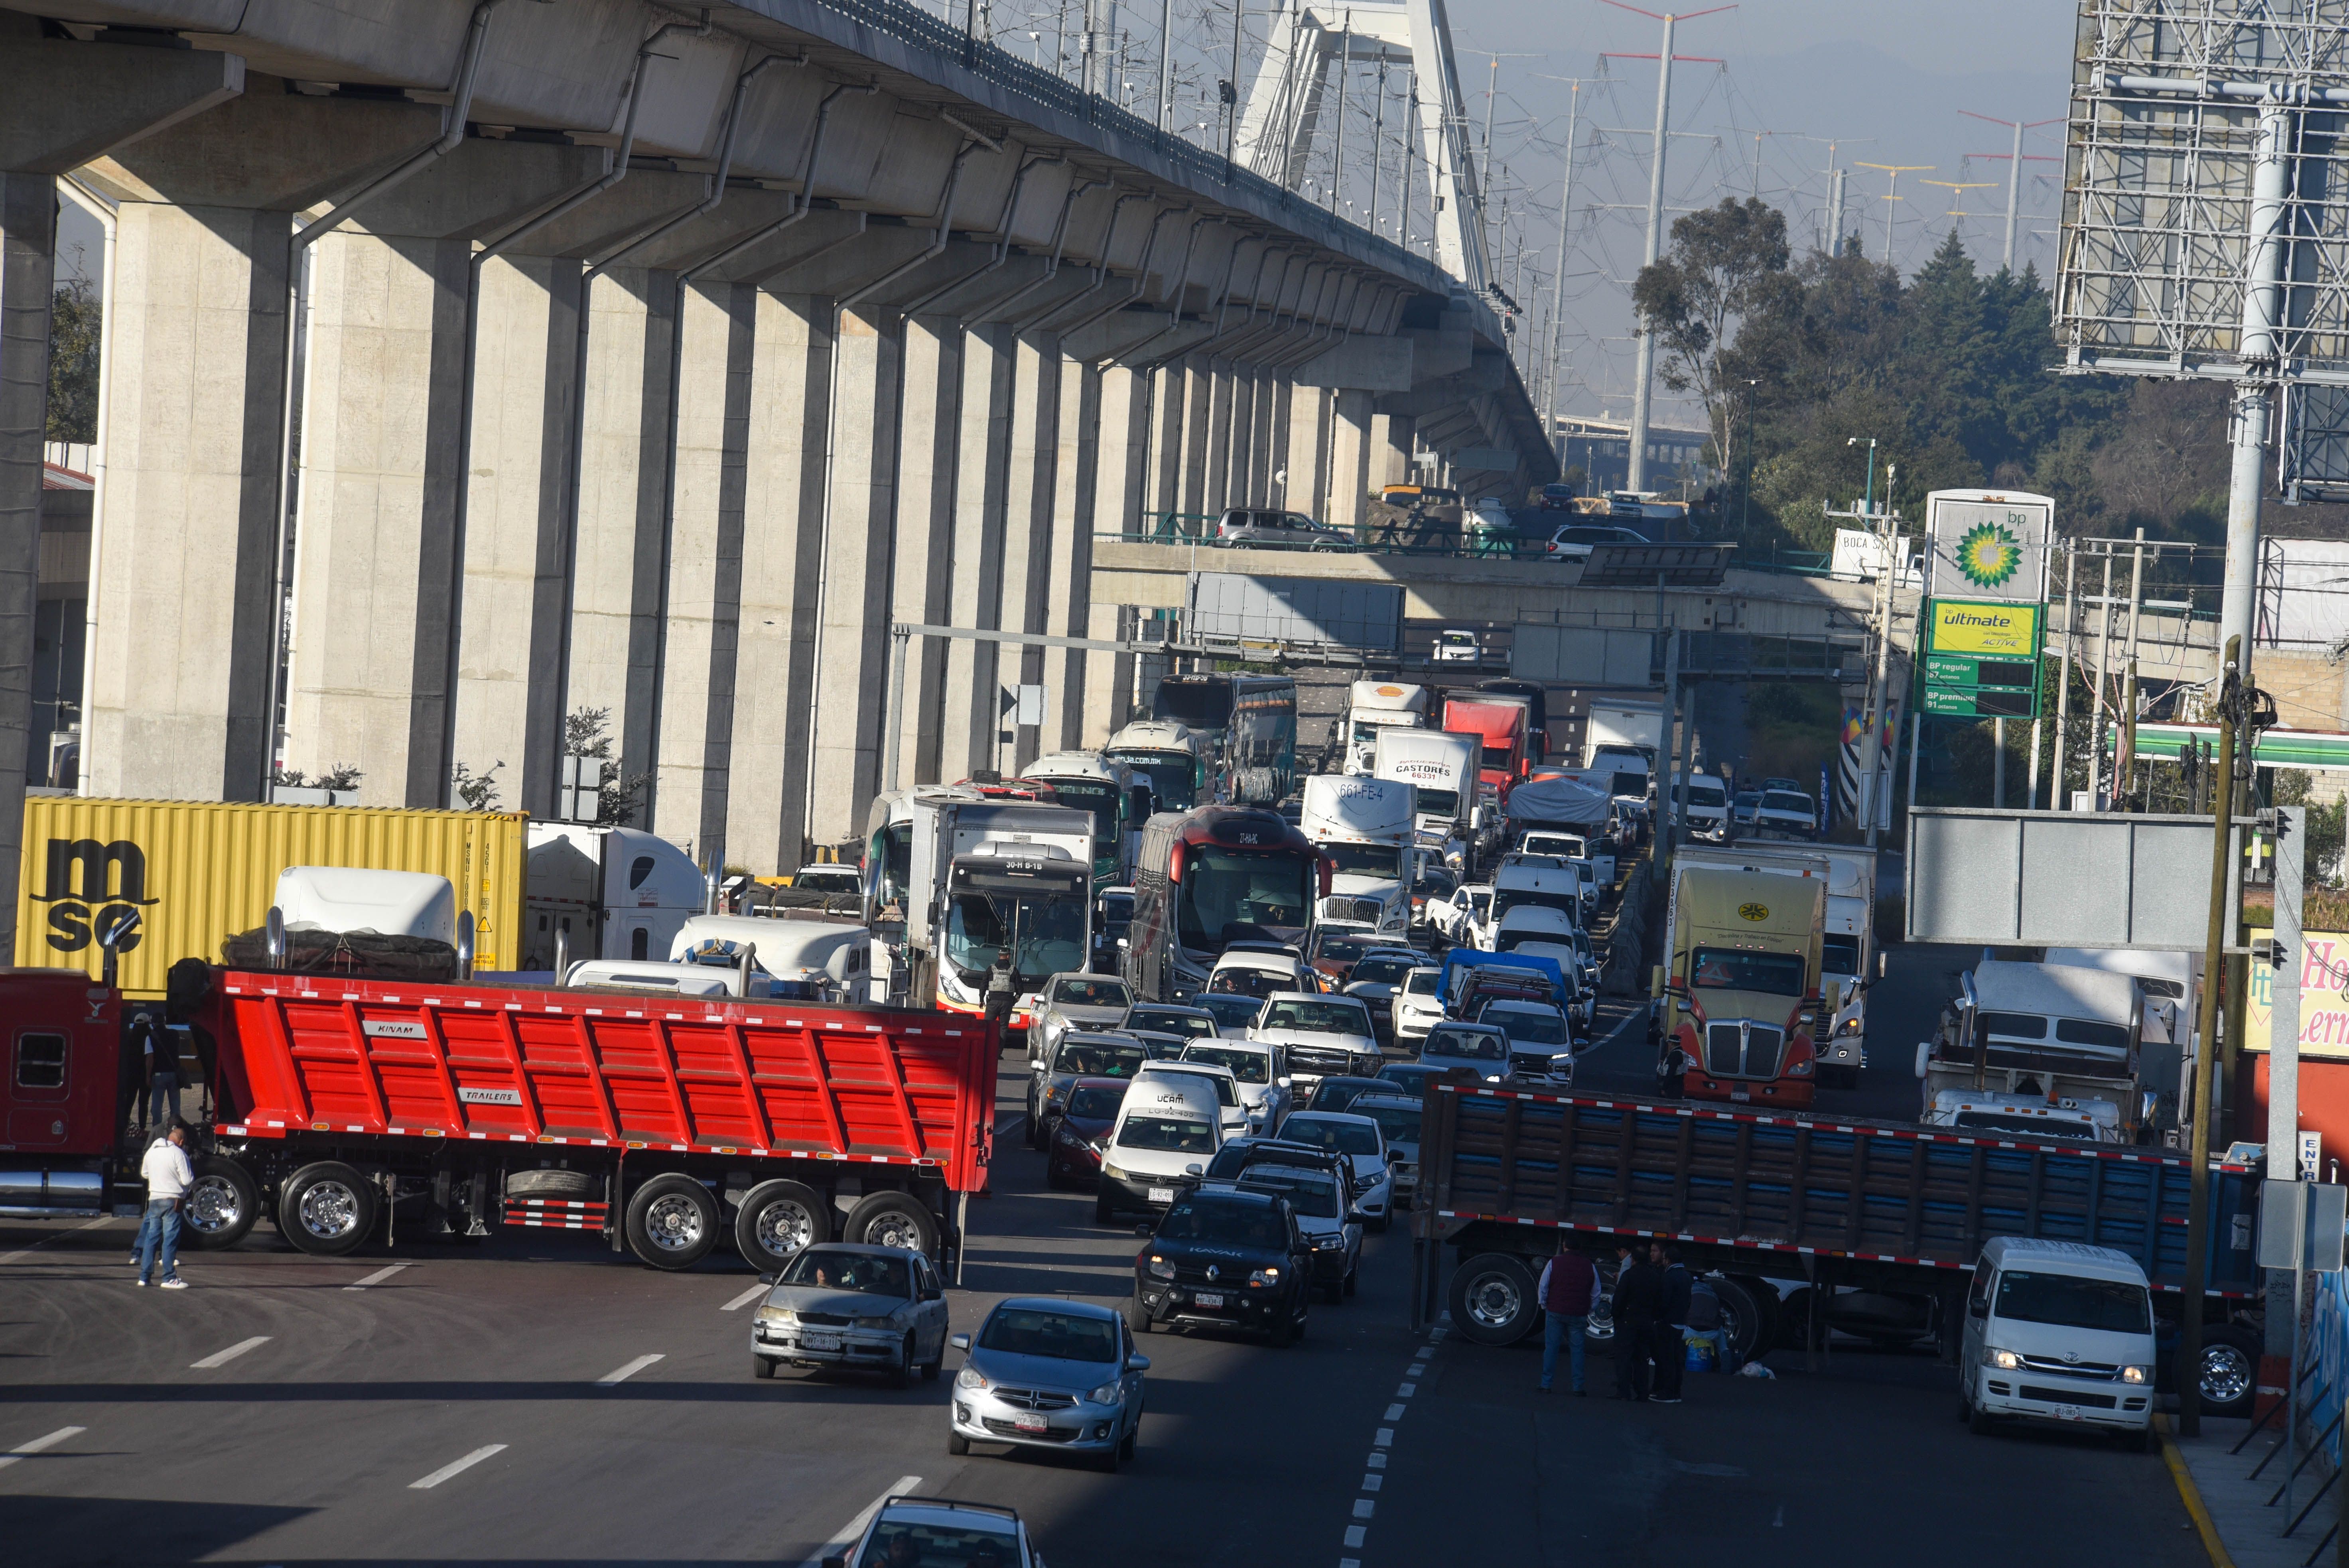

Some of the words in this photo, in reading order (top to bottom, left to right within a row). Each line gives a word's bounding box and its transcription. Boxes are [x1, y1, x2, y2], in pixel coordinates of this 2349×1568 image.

[2008, 510, 2026, 526] bp
[1844, 537, 1867, 548] BOCA
[1945, 613, 2010, 627] ultimate
[1943, 664, 1971, 672] regular
[1396, 765, 1450, 776] CASTORES
[1340, 784, 1383, 801] 661-FE-4
[466, 1091, 513, 1101] TRAILERS
[1157, 1095, 1184, 1104] UCAM
[1148, 1108, 1194, 1118] LG-92-455
[1190, 1247, 1243, 1257] KAVAK
